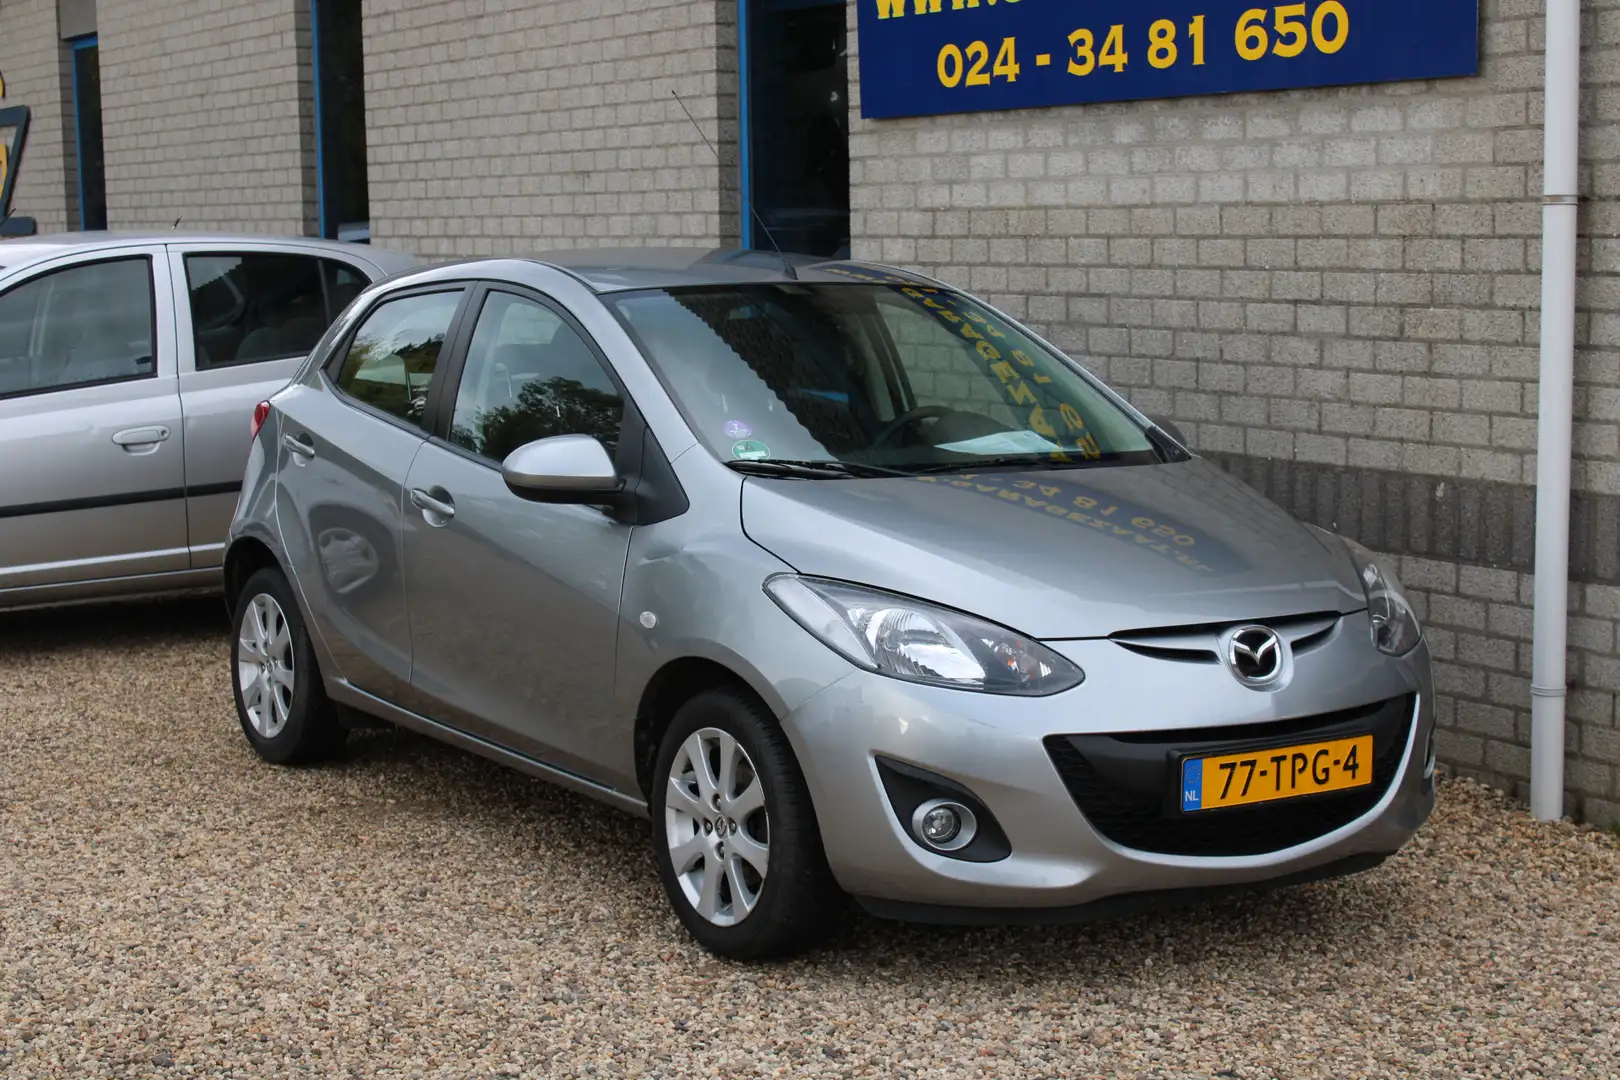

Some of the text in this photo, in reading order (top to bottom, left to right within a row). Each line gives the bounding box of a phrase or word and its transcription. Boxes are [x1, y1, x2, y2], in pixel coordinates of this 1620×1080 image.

[937, 36, 1021, 88] 024
[1067, 24, 1129, 77] 34
[1146, 14, 1206, 70] 81
[1234, 0, 1350, 61] 650
[1185, 790, 1198, 802] NL
[1219, 744, 1359, 800] 77-TPG-4
